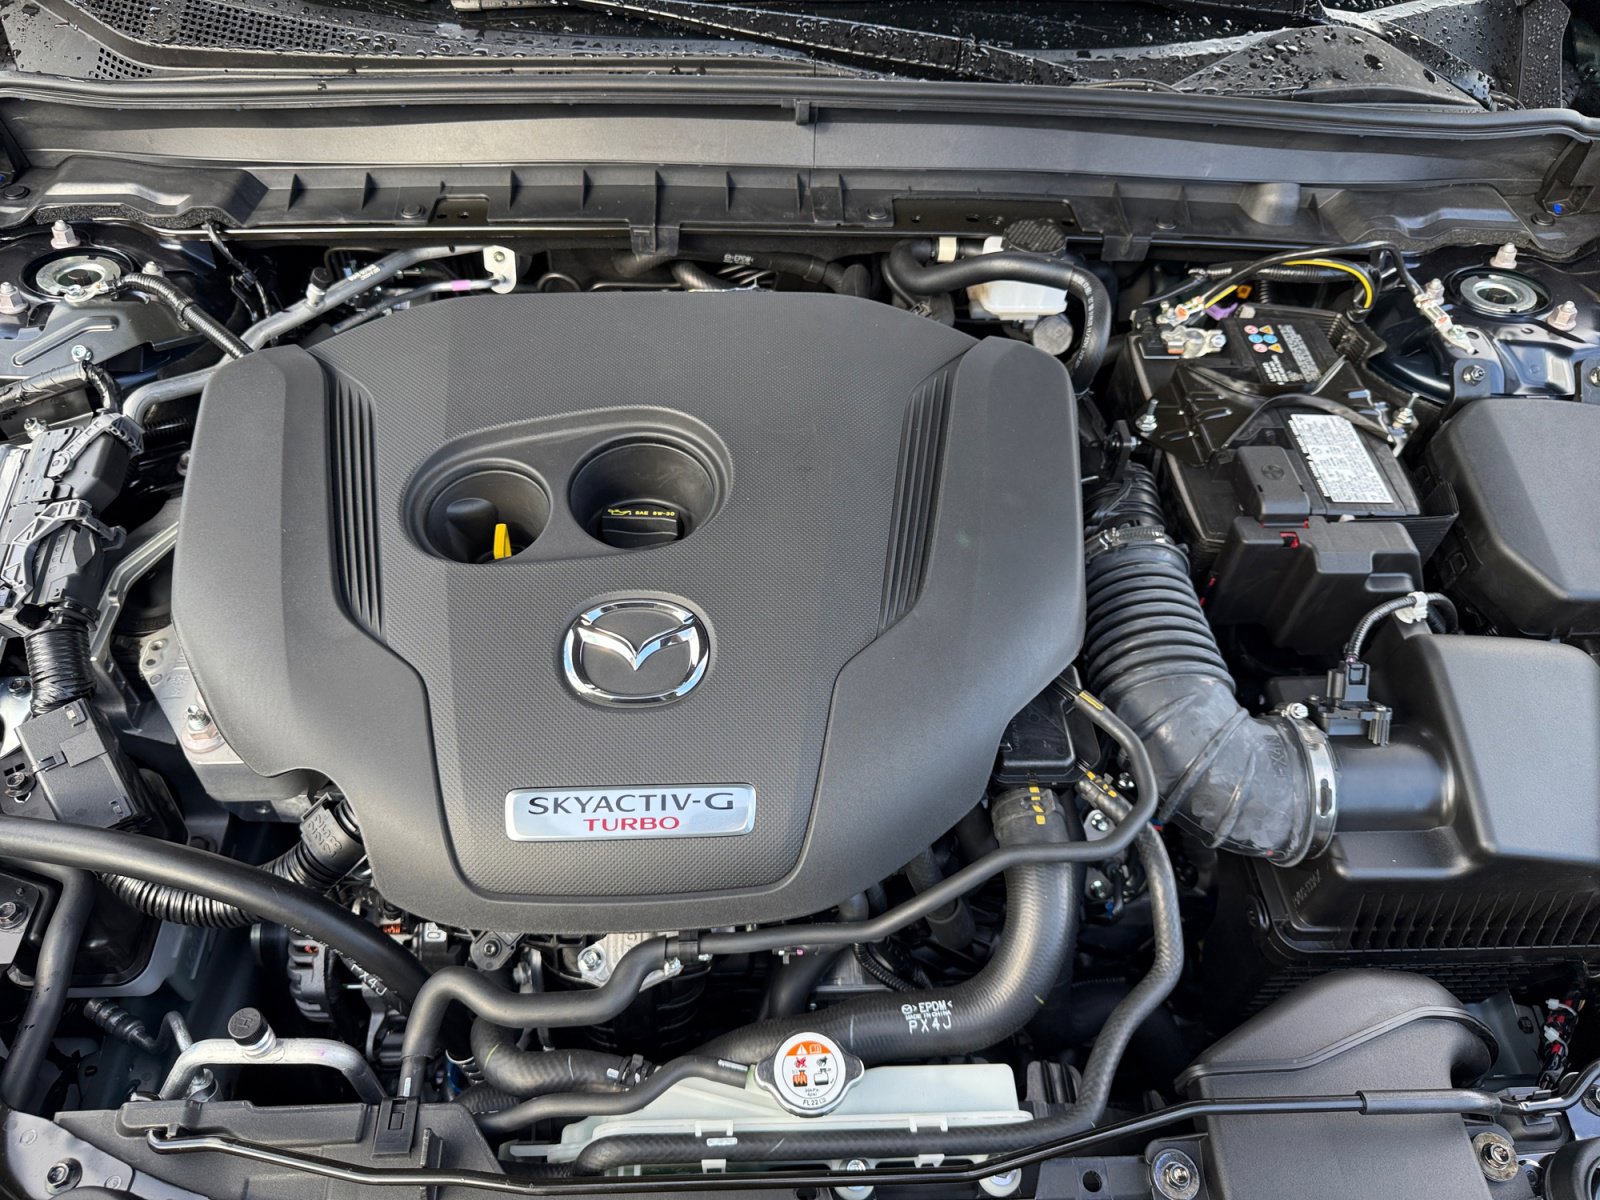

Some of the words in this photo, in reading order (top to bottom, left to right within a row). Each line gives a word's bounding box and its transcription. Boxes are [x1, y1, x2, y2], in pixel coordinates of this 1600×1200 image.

[528, 792, 734, 815] SKYACTIV-G
[583, 816, 680, 832] TURBO
[909, 1015, 952, 1035] PX4J
